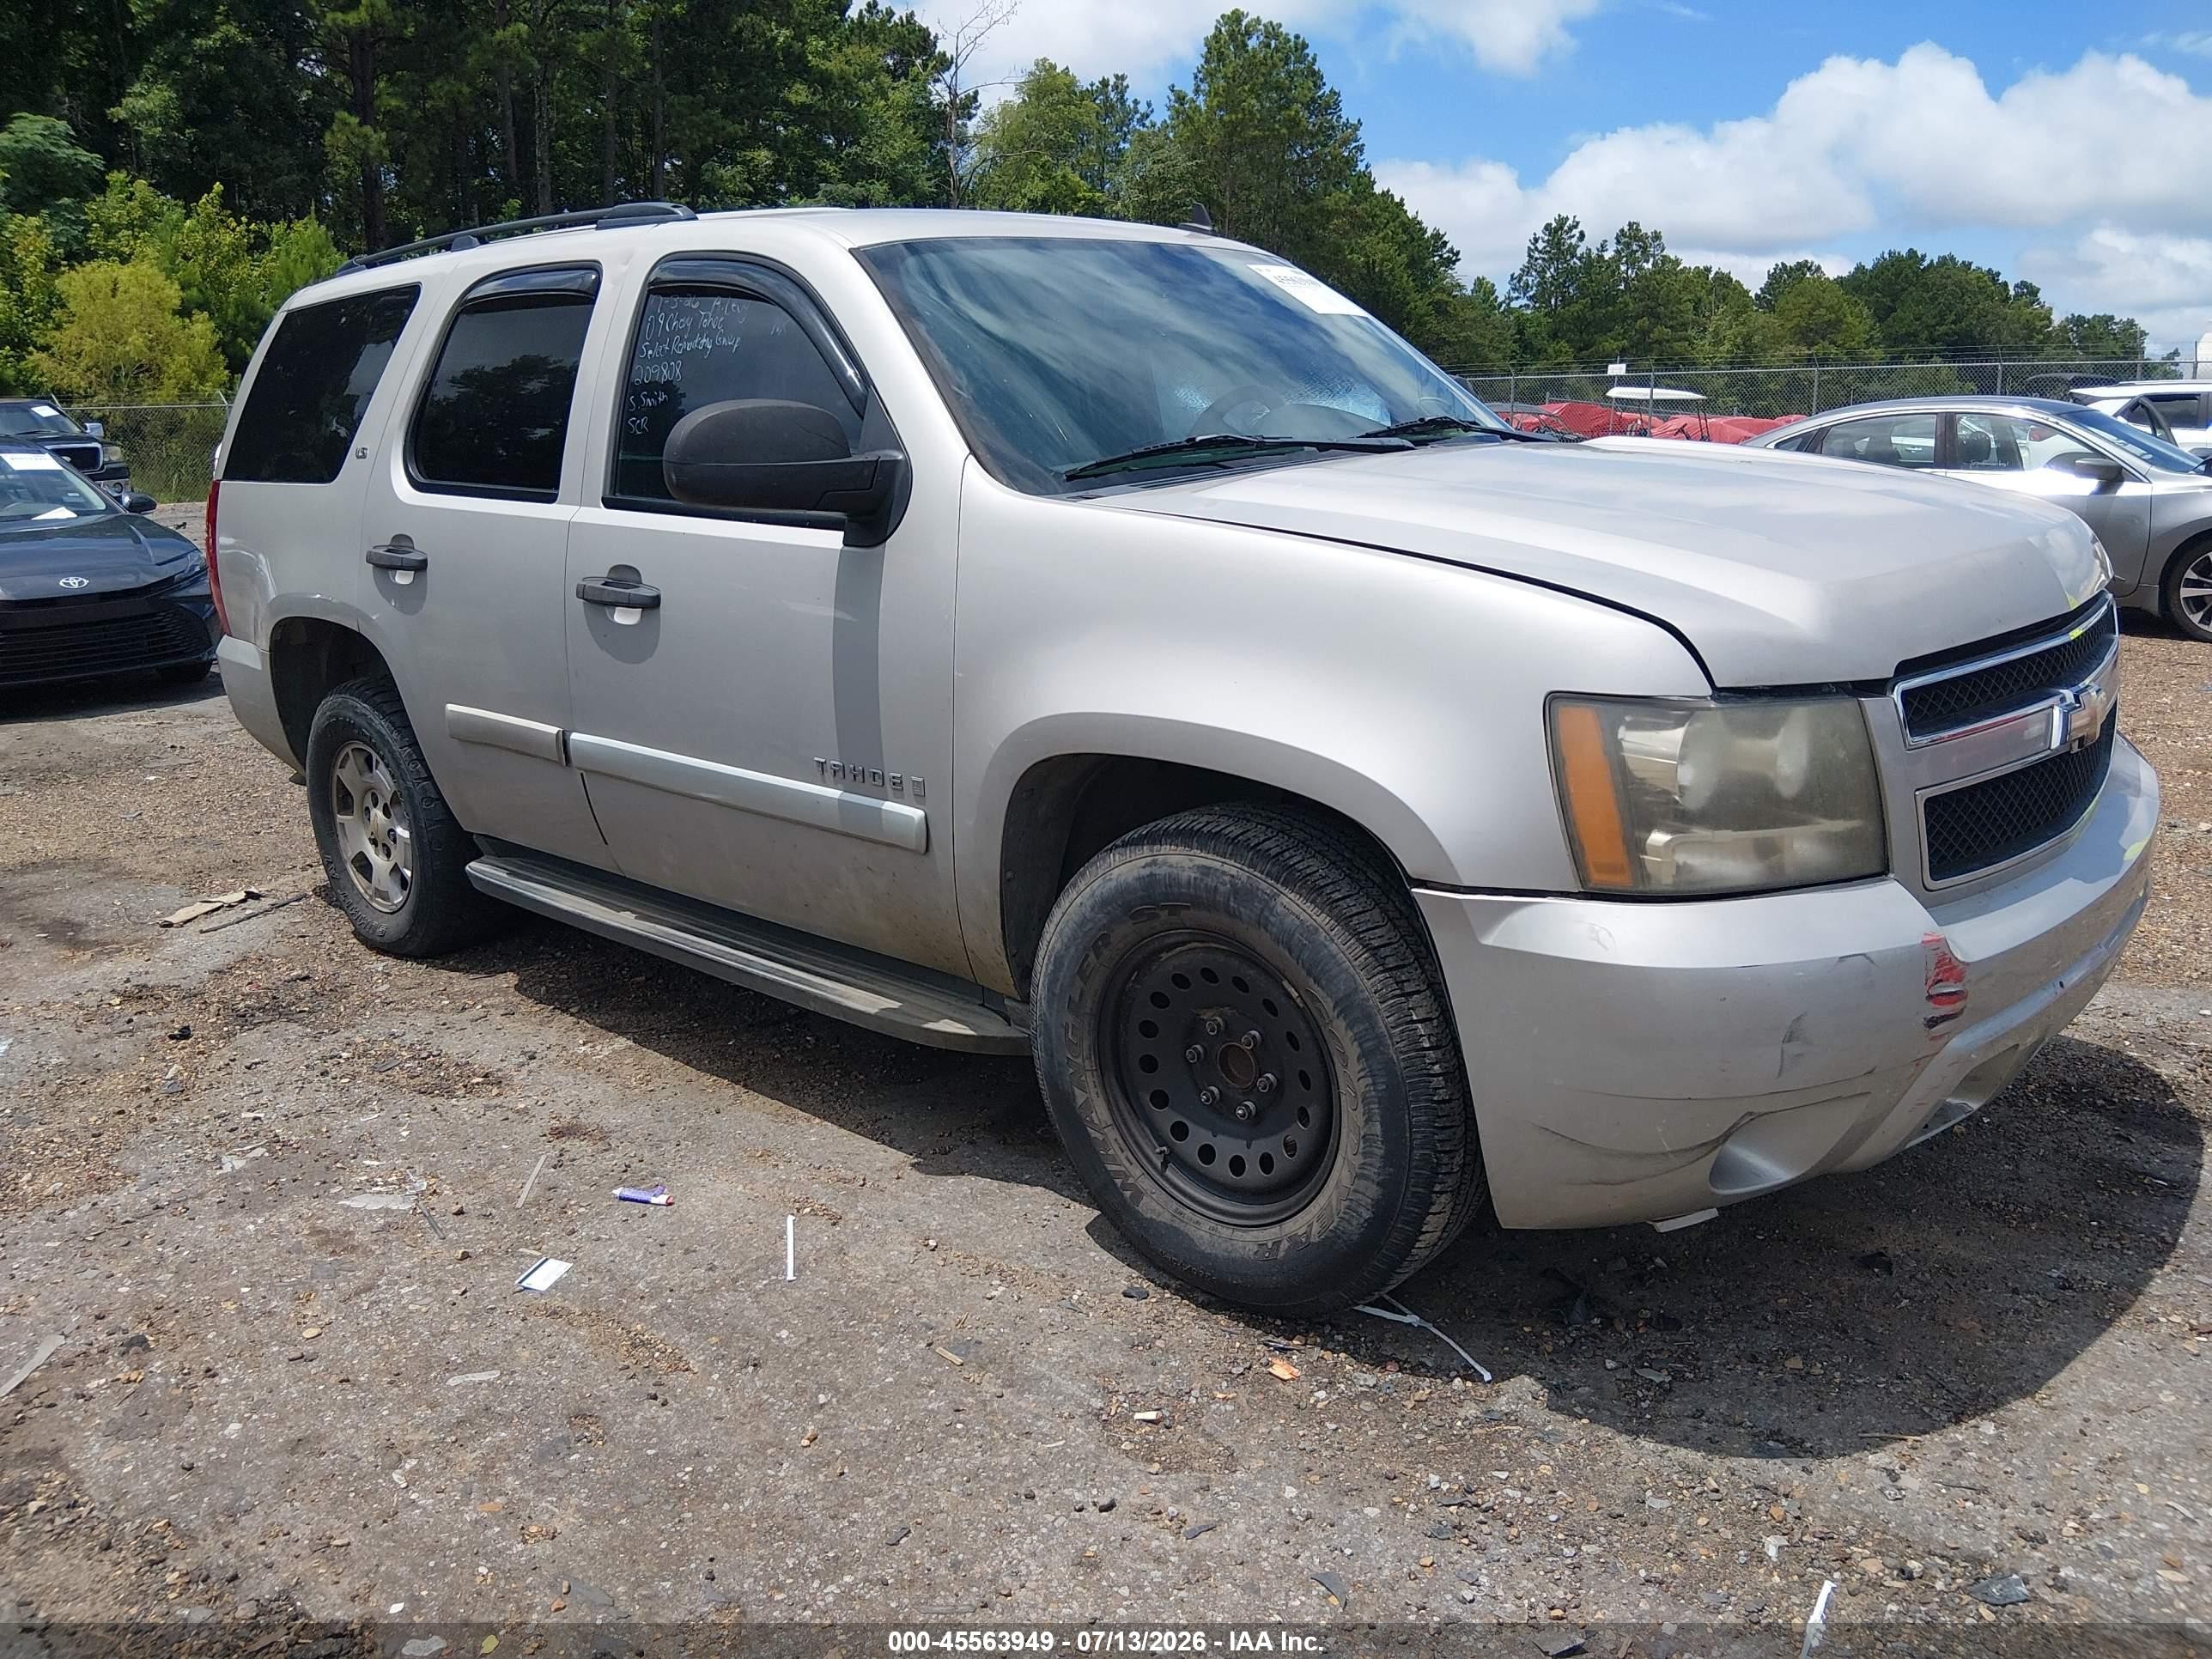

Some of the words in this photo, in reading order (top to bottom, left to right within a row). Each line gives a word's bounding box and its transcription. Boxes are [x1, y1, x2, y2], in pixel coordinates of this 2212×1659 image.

[645, 312, 665, 342] 09
[633, 359, 683, 386] 209808
[812, 756, 904, 792] TAHOE
